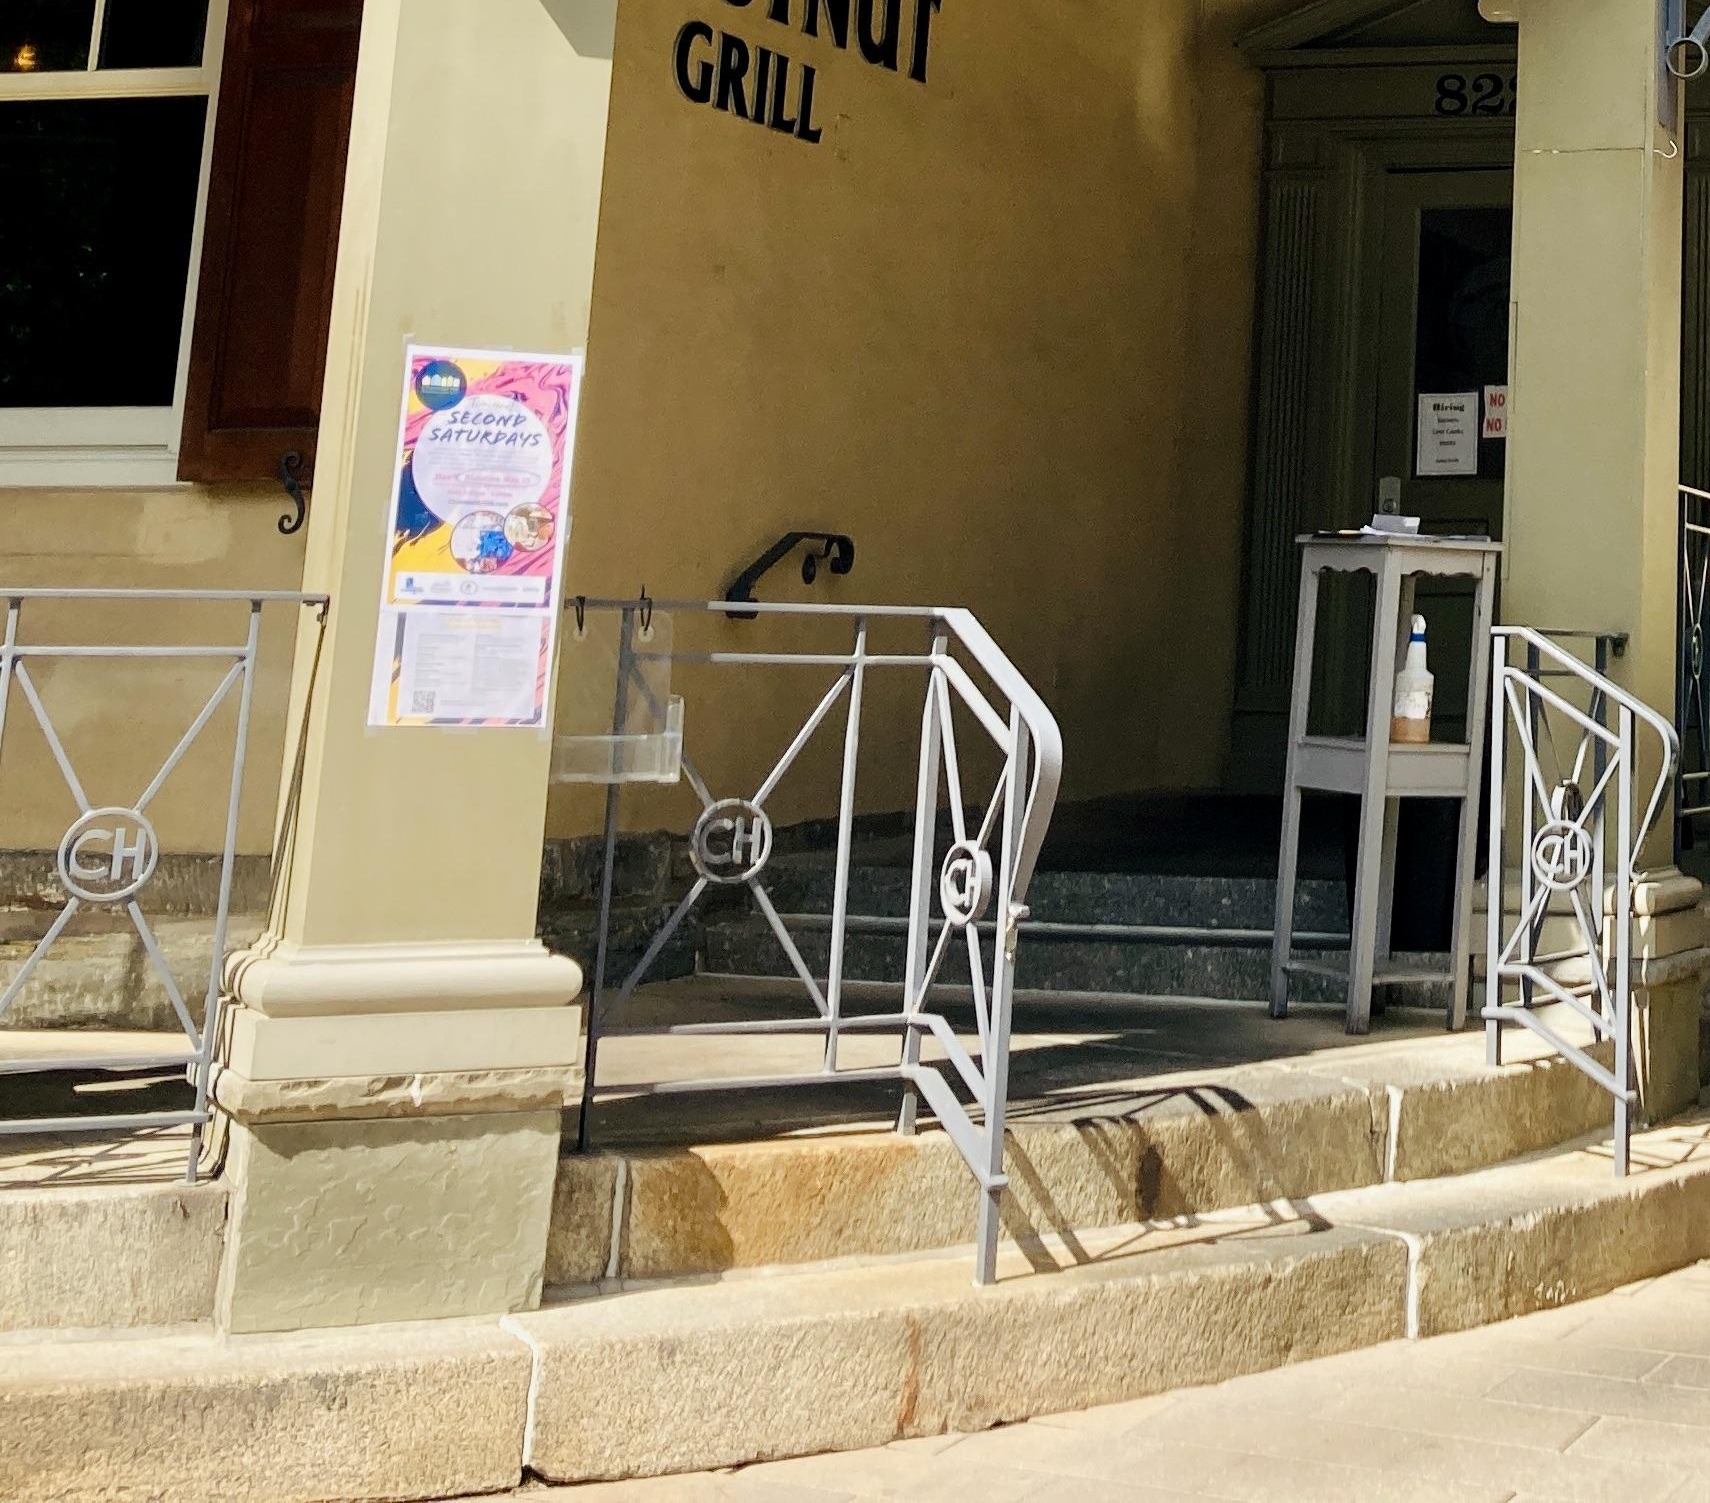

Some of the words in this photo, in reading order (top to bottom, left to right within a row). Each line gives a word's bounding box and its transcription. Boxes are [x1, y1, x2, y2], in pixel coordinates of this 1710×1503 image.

[672, 20, 822, 144] GRILL
[1432, 402, 1465, 412] Hiring
[1489, 393, 1505, 407] NO
[447, 410, 527, 427] SECOND
[1485, 417, 1502, 431] NO
[428, 427, 543, 447] SATURDAYS
[68, 827, 147, 881] CH
